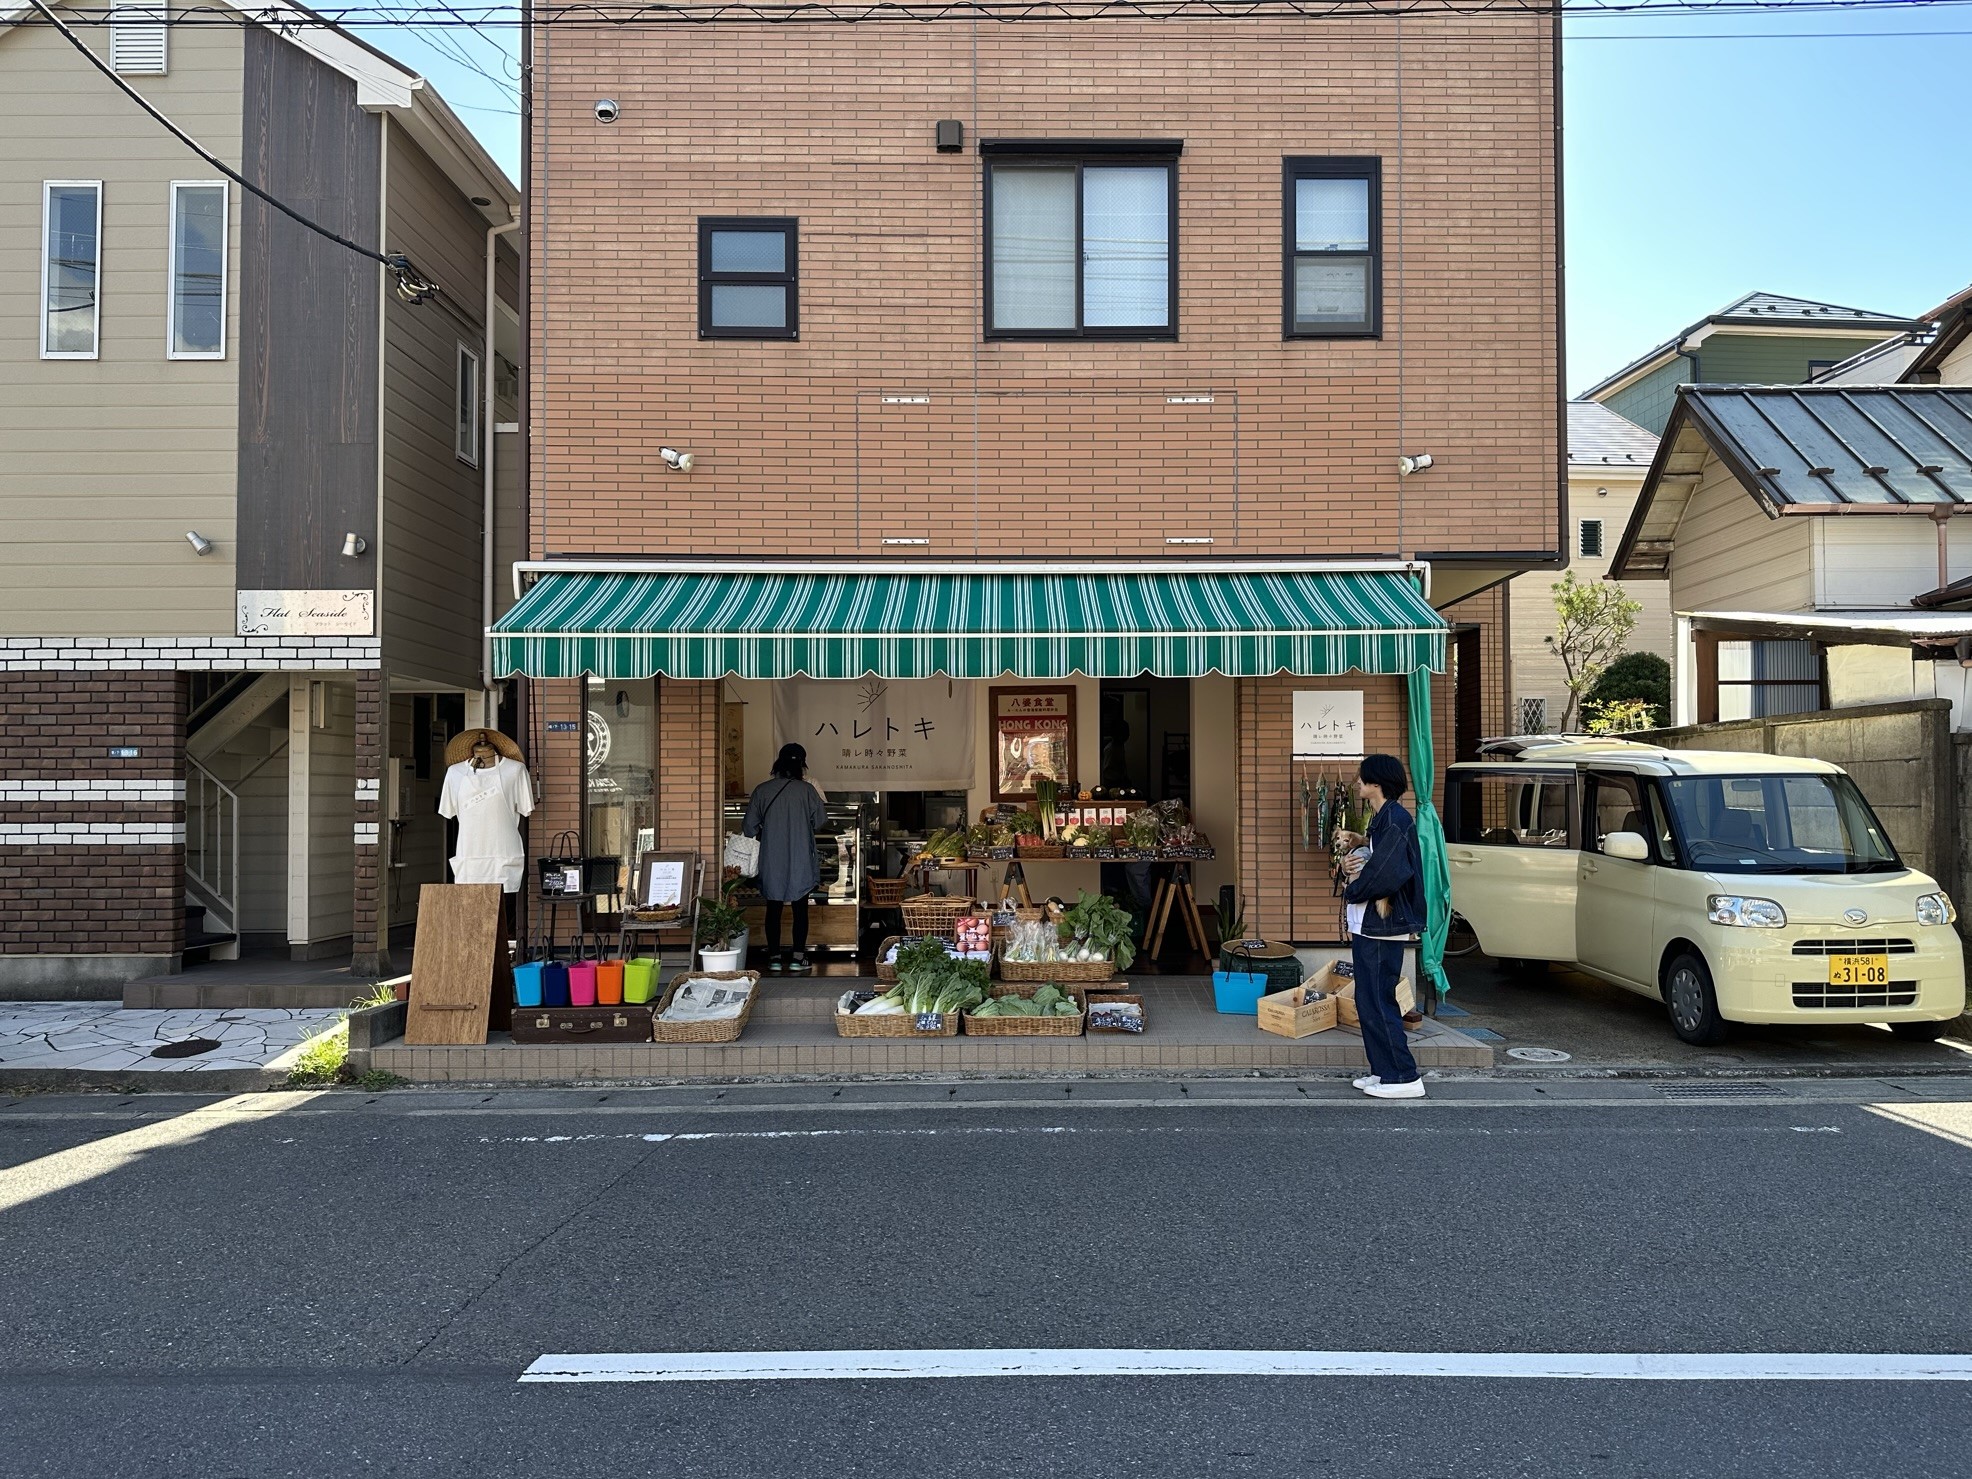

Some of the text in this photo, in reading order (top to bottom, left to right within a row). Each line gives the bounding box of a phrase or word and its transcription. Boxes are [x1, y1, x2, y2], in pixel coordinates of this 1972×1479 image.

[260, 606, 348, 618] Flat Seaside
[815, 717, 936, 741] ハレトキ
[998, 719, 1067, 730] HONG KONG
[1300, 719, 1357, 732] ハレトキ
[841, 748, 908, 759] 晴レ時々野菜
[1833, 967, 1885, 982] ぬ 31-08
